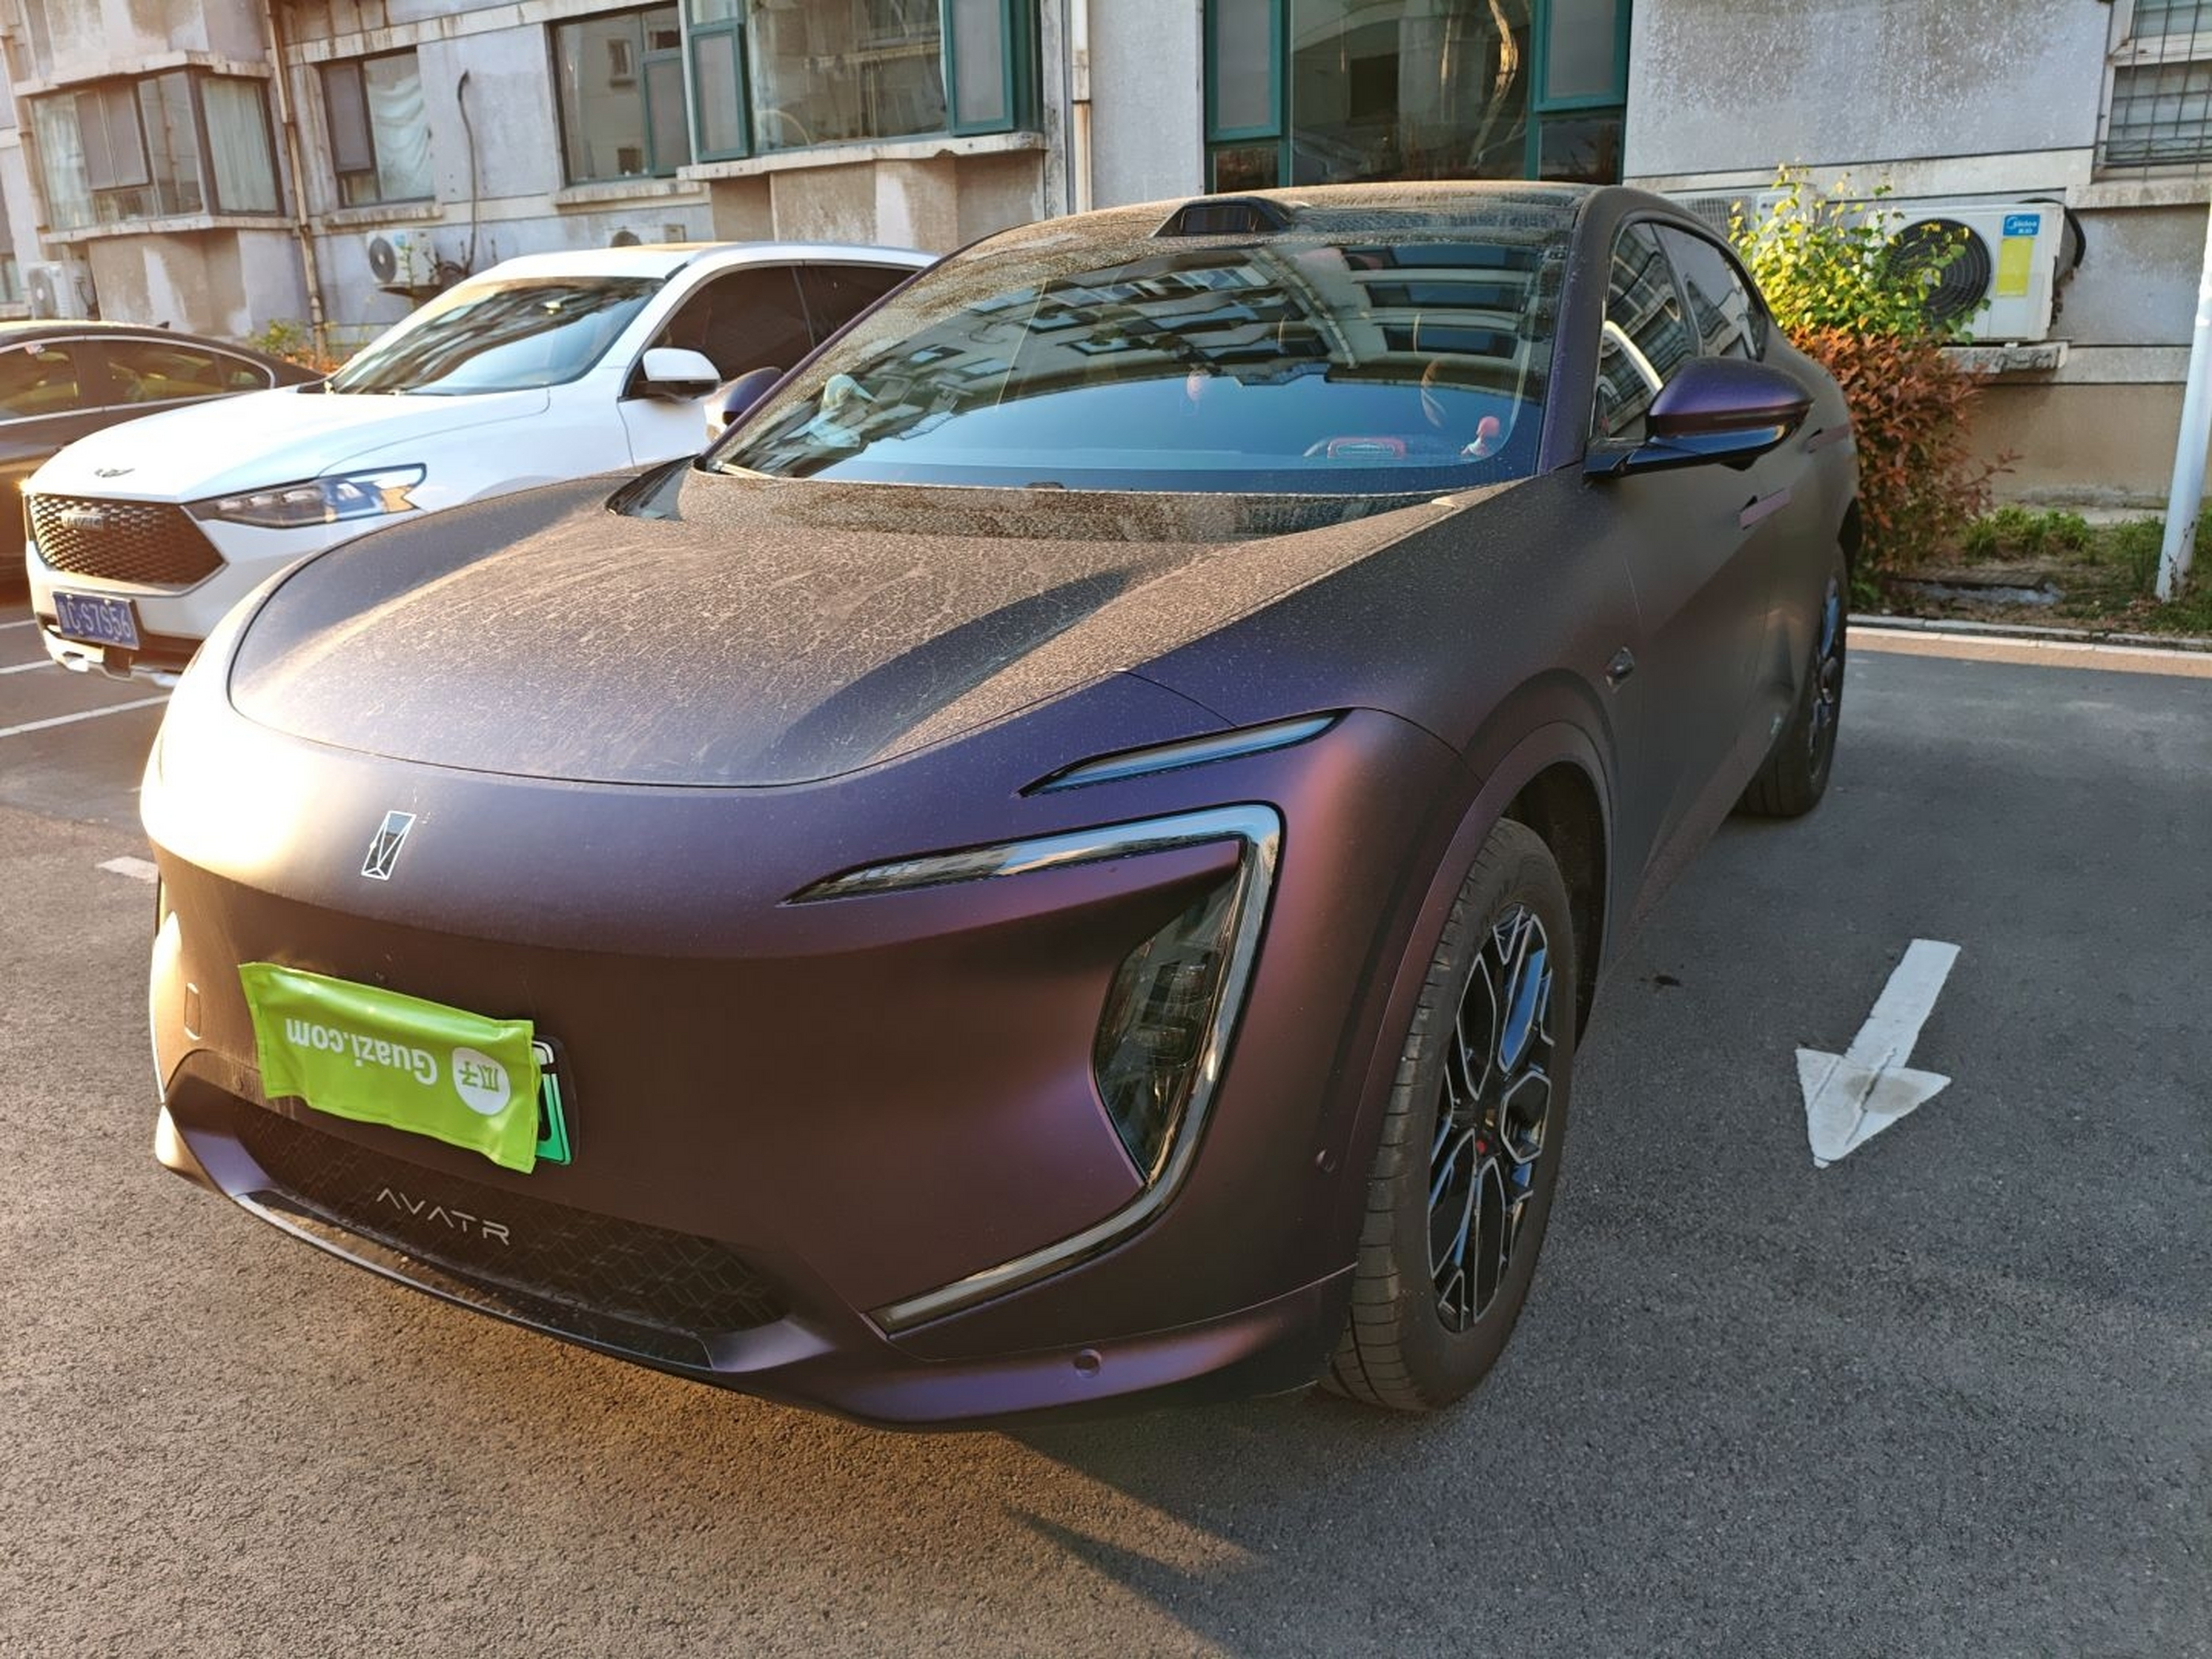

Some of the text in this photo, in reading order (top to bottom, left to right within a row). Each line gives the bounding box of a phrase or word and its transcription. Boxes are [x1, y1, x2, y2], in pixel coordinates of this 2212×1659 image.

[285, 1017, 500, 1093] 瓜子 Guazi.com
[376, 1187, 509, 1246] AVATR
